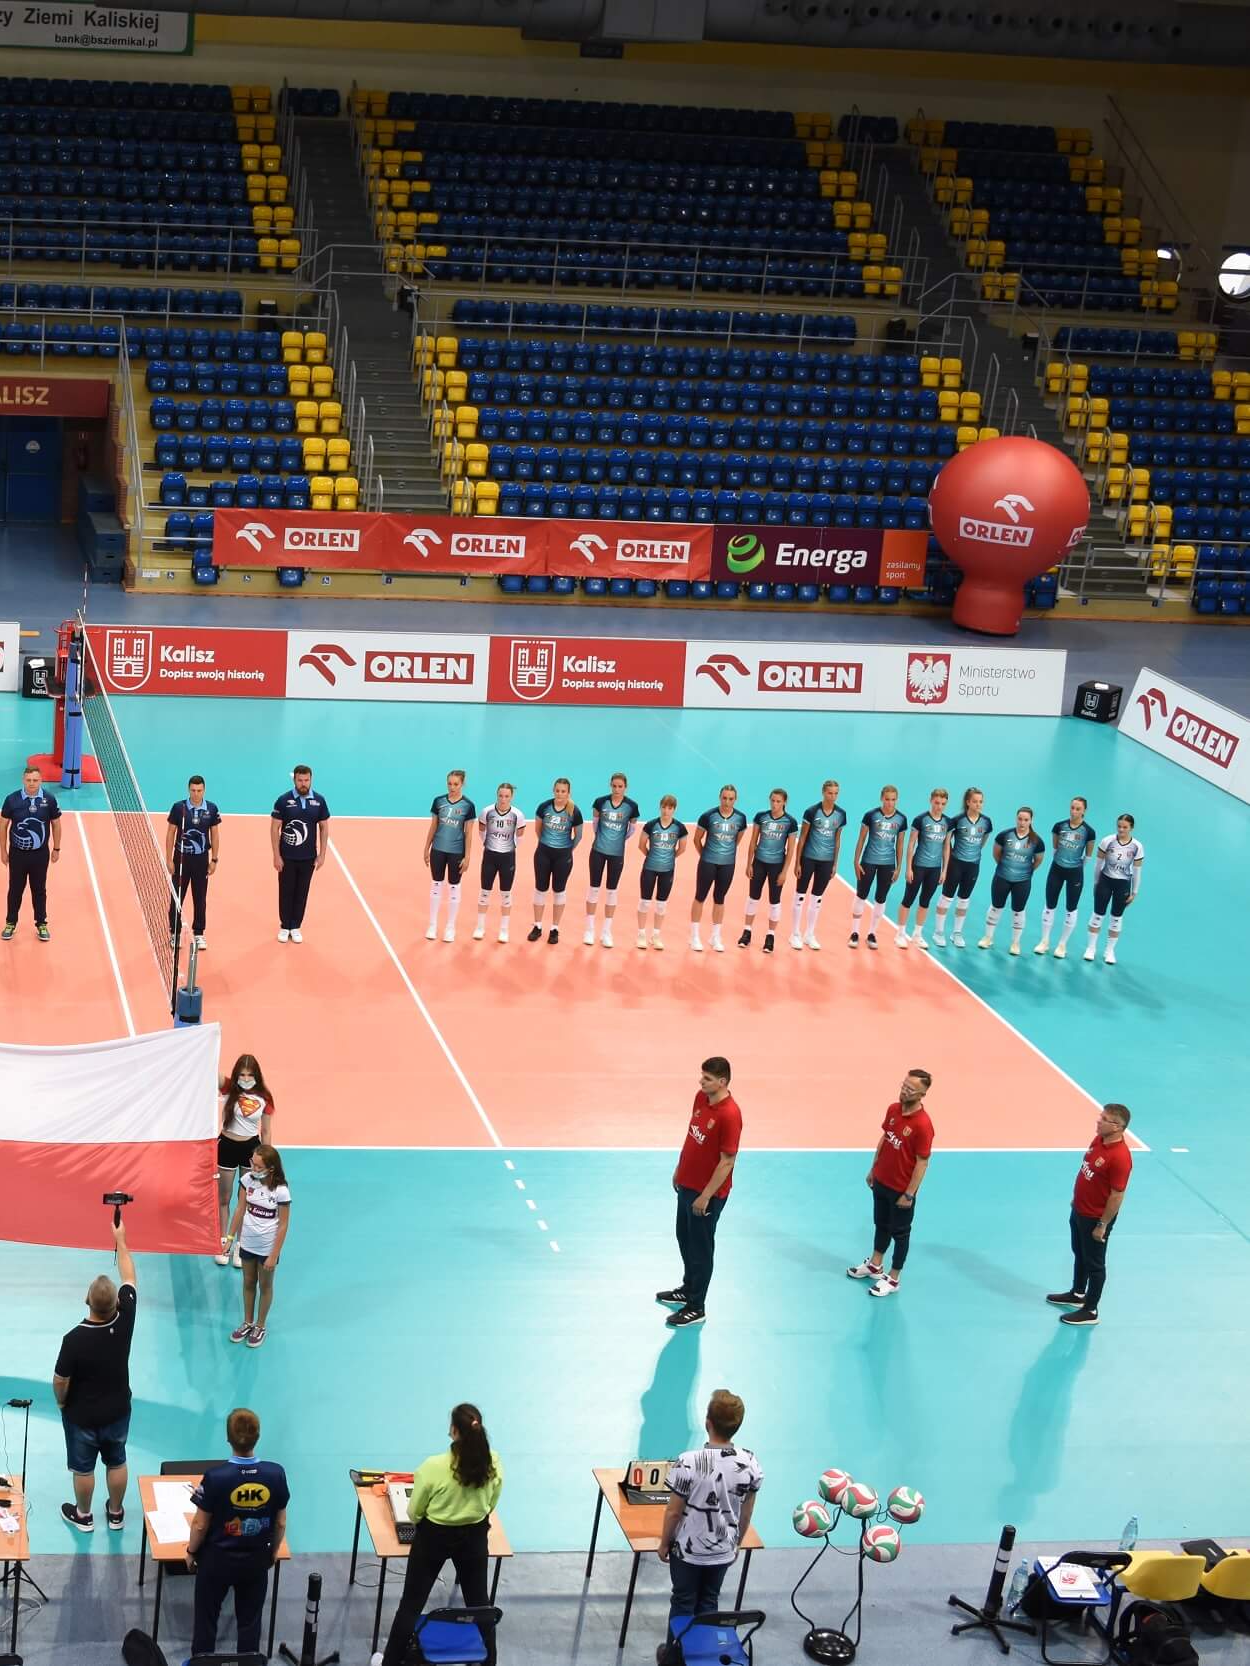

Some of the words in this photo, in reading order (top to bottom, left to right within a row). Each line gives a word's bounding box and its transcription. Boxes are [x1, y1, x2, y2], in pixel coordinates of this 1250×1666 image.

[23, 7, 73, 26] Ziemi
[84, 9, 159, 31] Kaliskiej
[54, 33, 158, 48] bank@bsziemikal.pl
[288, 531, 355, 548] ORLEN
[963, 522, 1028, 544] ORLEN
[455, 537, 521, 554] ORLEN
[620, 542, 686, 560] ORLEN
[775, 542, 868, 575] Energa
[885, 559, 921, 571] zasilamy
[885, 571, 906, 580] sport
[160, 645, 215, 663] Kalisz
[369, 655, 468, 681] ORLEN
[562, 655, 616, 674] Kalisz
[959, 665, 1036, 680] Ministerstwo
[159, 668, 193, 680] Dopisz
[196, 670, 225, 681] swoją
[227, 669, 265, 682] historię
[763, 665, 855, 689] ORLEN
[561, 678, 595, 690] Dopisz
[596, 680, 626, 691] swoją
[627, 679, 664, 692] historię
[958, 684, 999, 698] Sportu
[1171, 713, 1234, 763] ORLEN
[633, 1467, 644, 1485] 0
[649, 1468, 660, 1486] 0
[236, 1489, 264, 1502] HK
